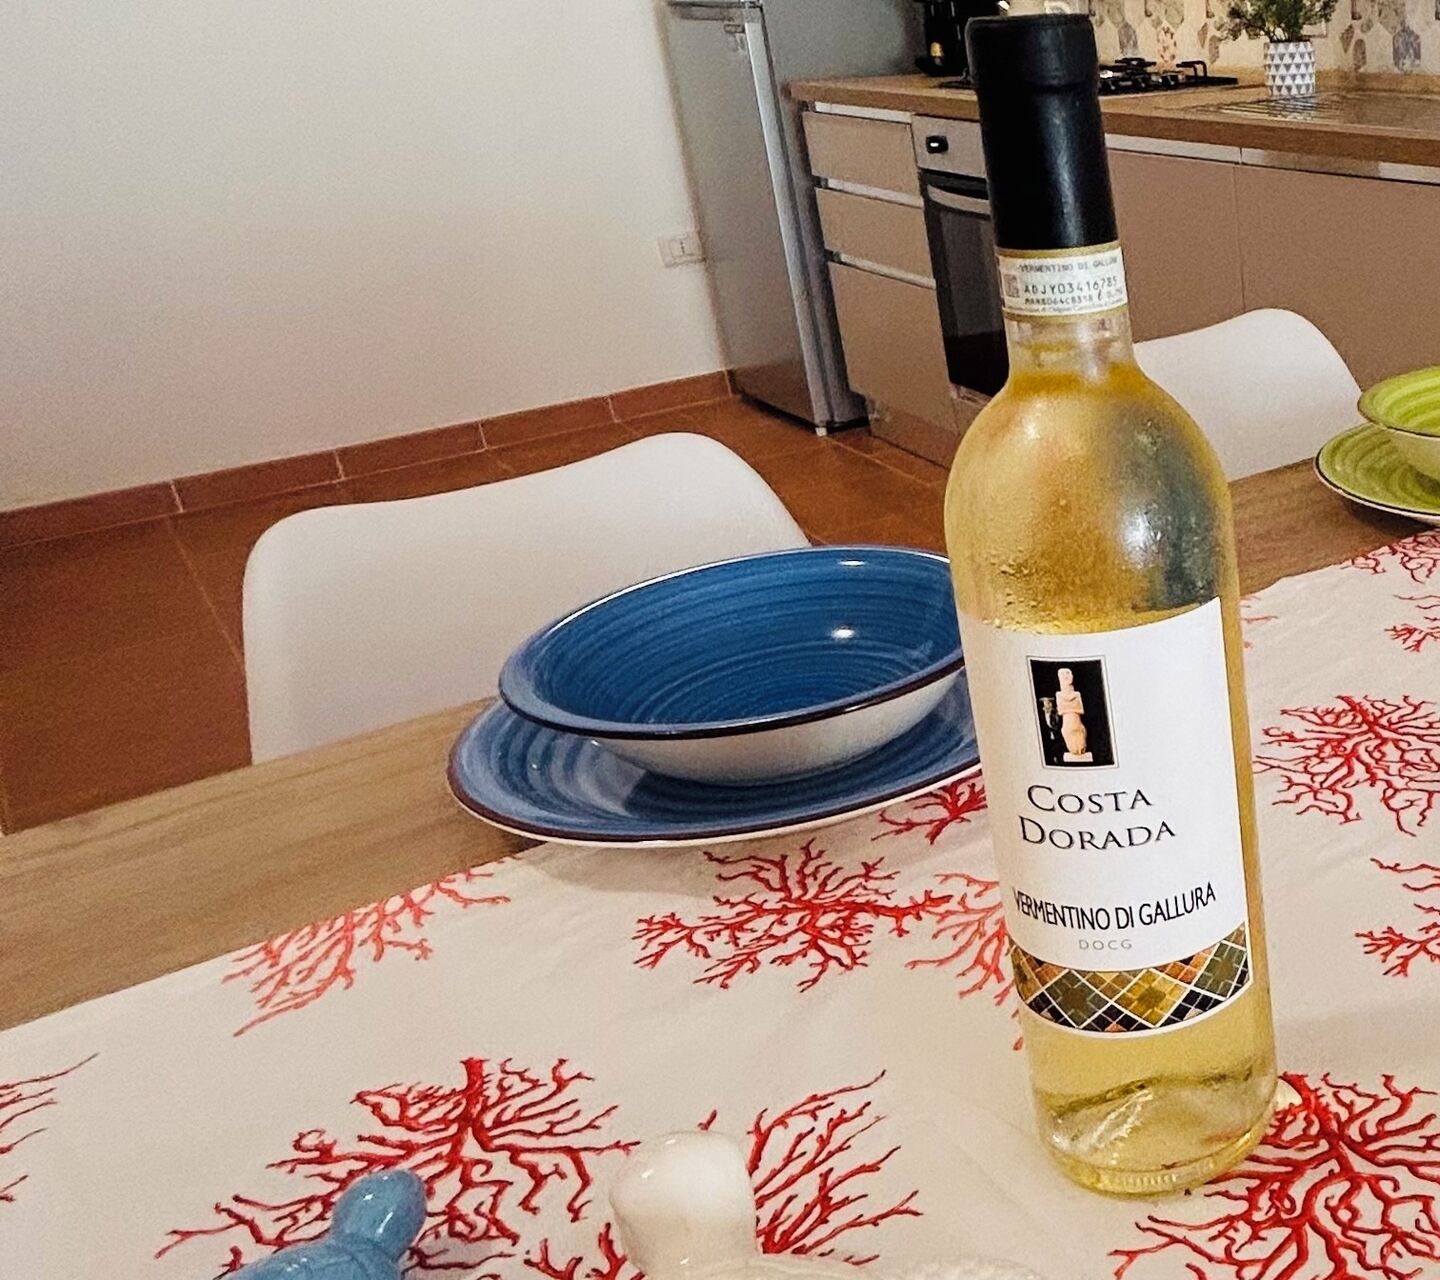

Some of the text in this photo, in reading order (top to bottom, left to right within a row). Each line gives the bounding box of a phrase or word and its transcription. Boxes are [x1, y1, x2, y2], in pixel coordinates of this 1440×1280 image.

[1027, 784, 1153, 815] COSTA
[1018, 815, 1177, 851] DORADA
[1011, 881, 1217, 931] VERMENTINO DI GALLURA
[1078, 938, 1133, 951] DOCG
